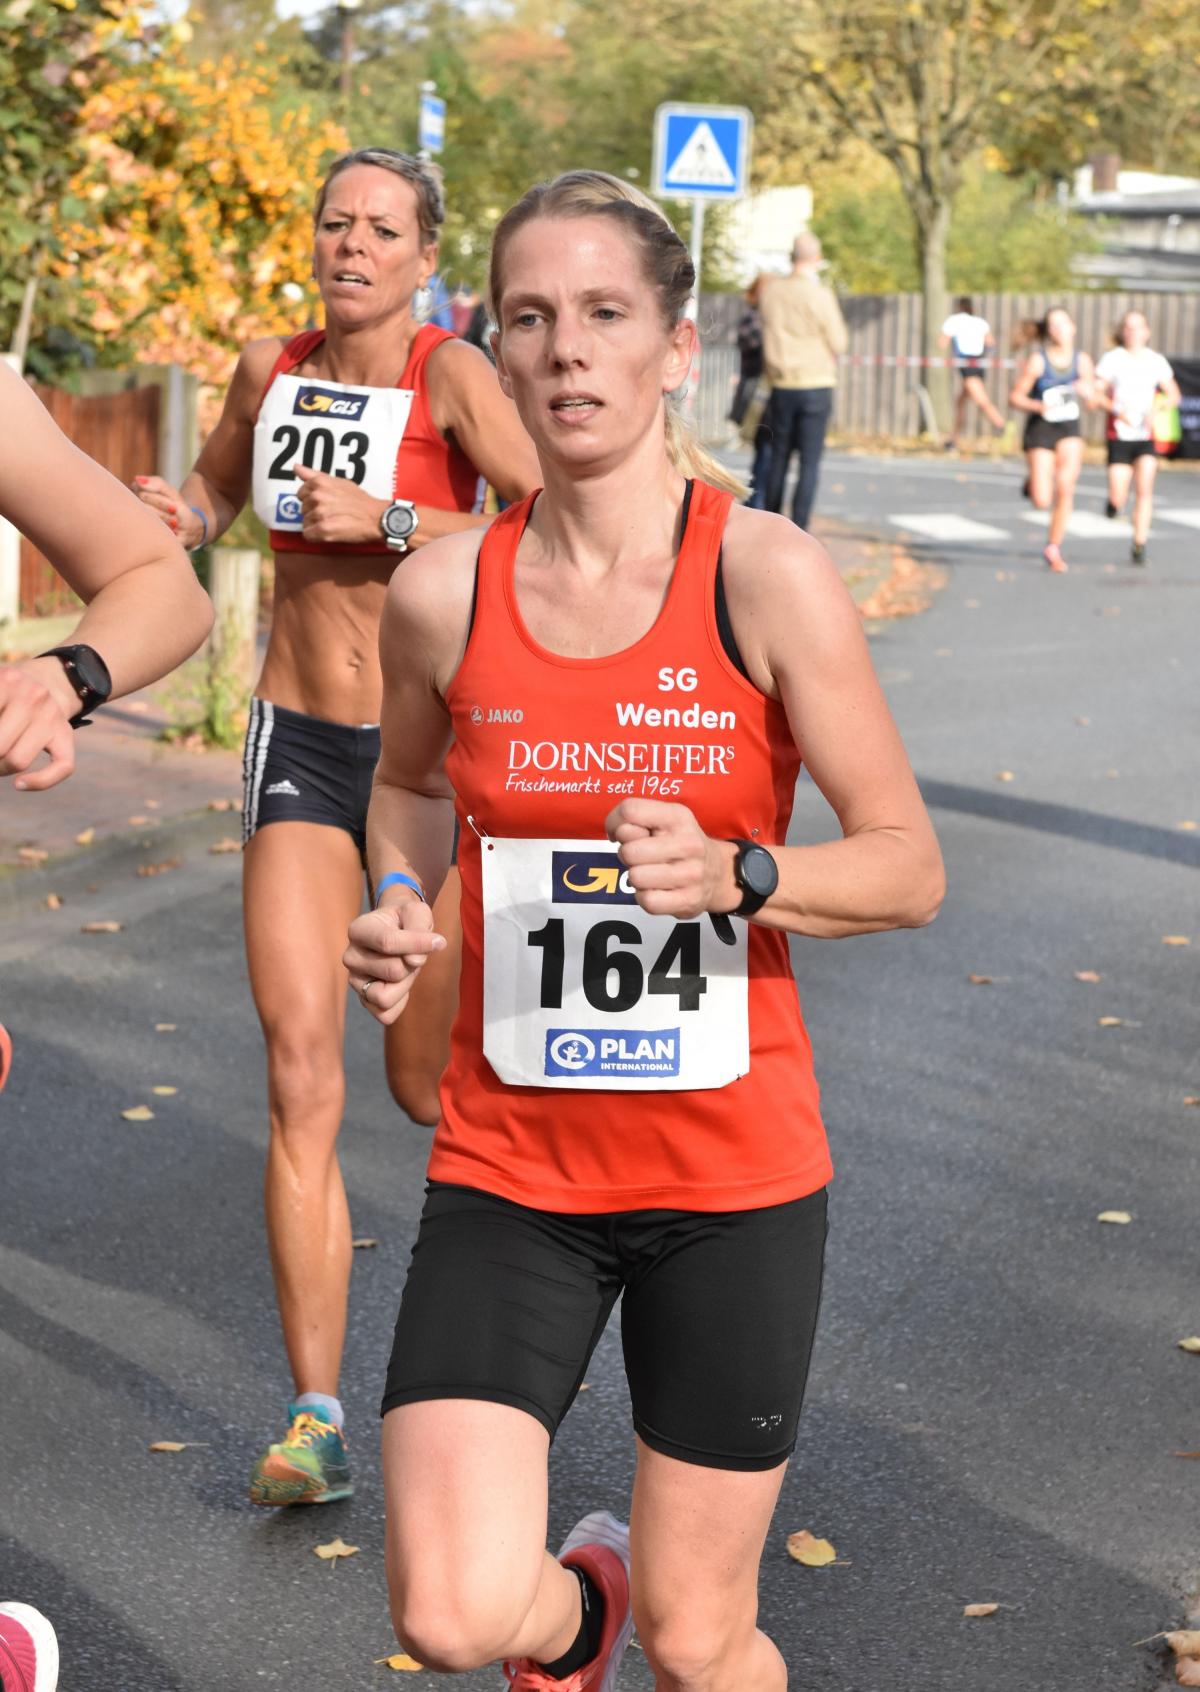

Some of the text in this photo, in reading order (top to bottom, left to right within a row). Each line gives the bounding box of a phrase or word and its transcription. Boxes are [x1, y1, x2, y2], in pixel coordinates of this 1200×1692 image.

[331, 400, 361, 415] GLS
[268, 425, 369, 485] 203
[657, 667, 698, 692] SG
[486, 709, 524, 724] JAKO
[615, 702, 736, 729] Wenden
[505, 773, 683, 796] Frischemarkt seit 1965
[527, 918, 707, 1013] 164
[600, 1038, 675, 1060] PLAN
[600, 1062, 674, 1071] INTERNATIONAL
